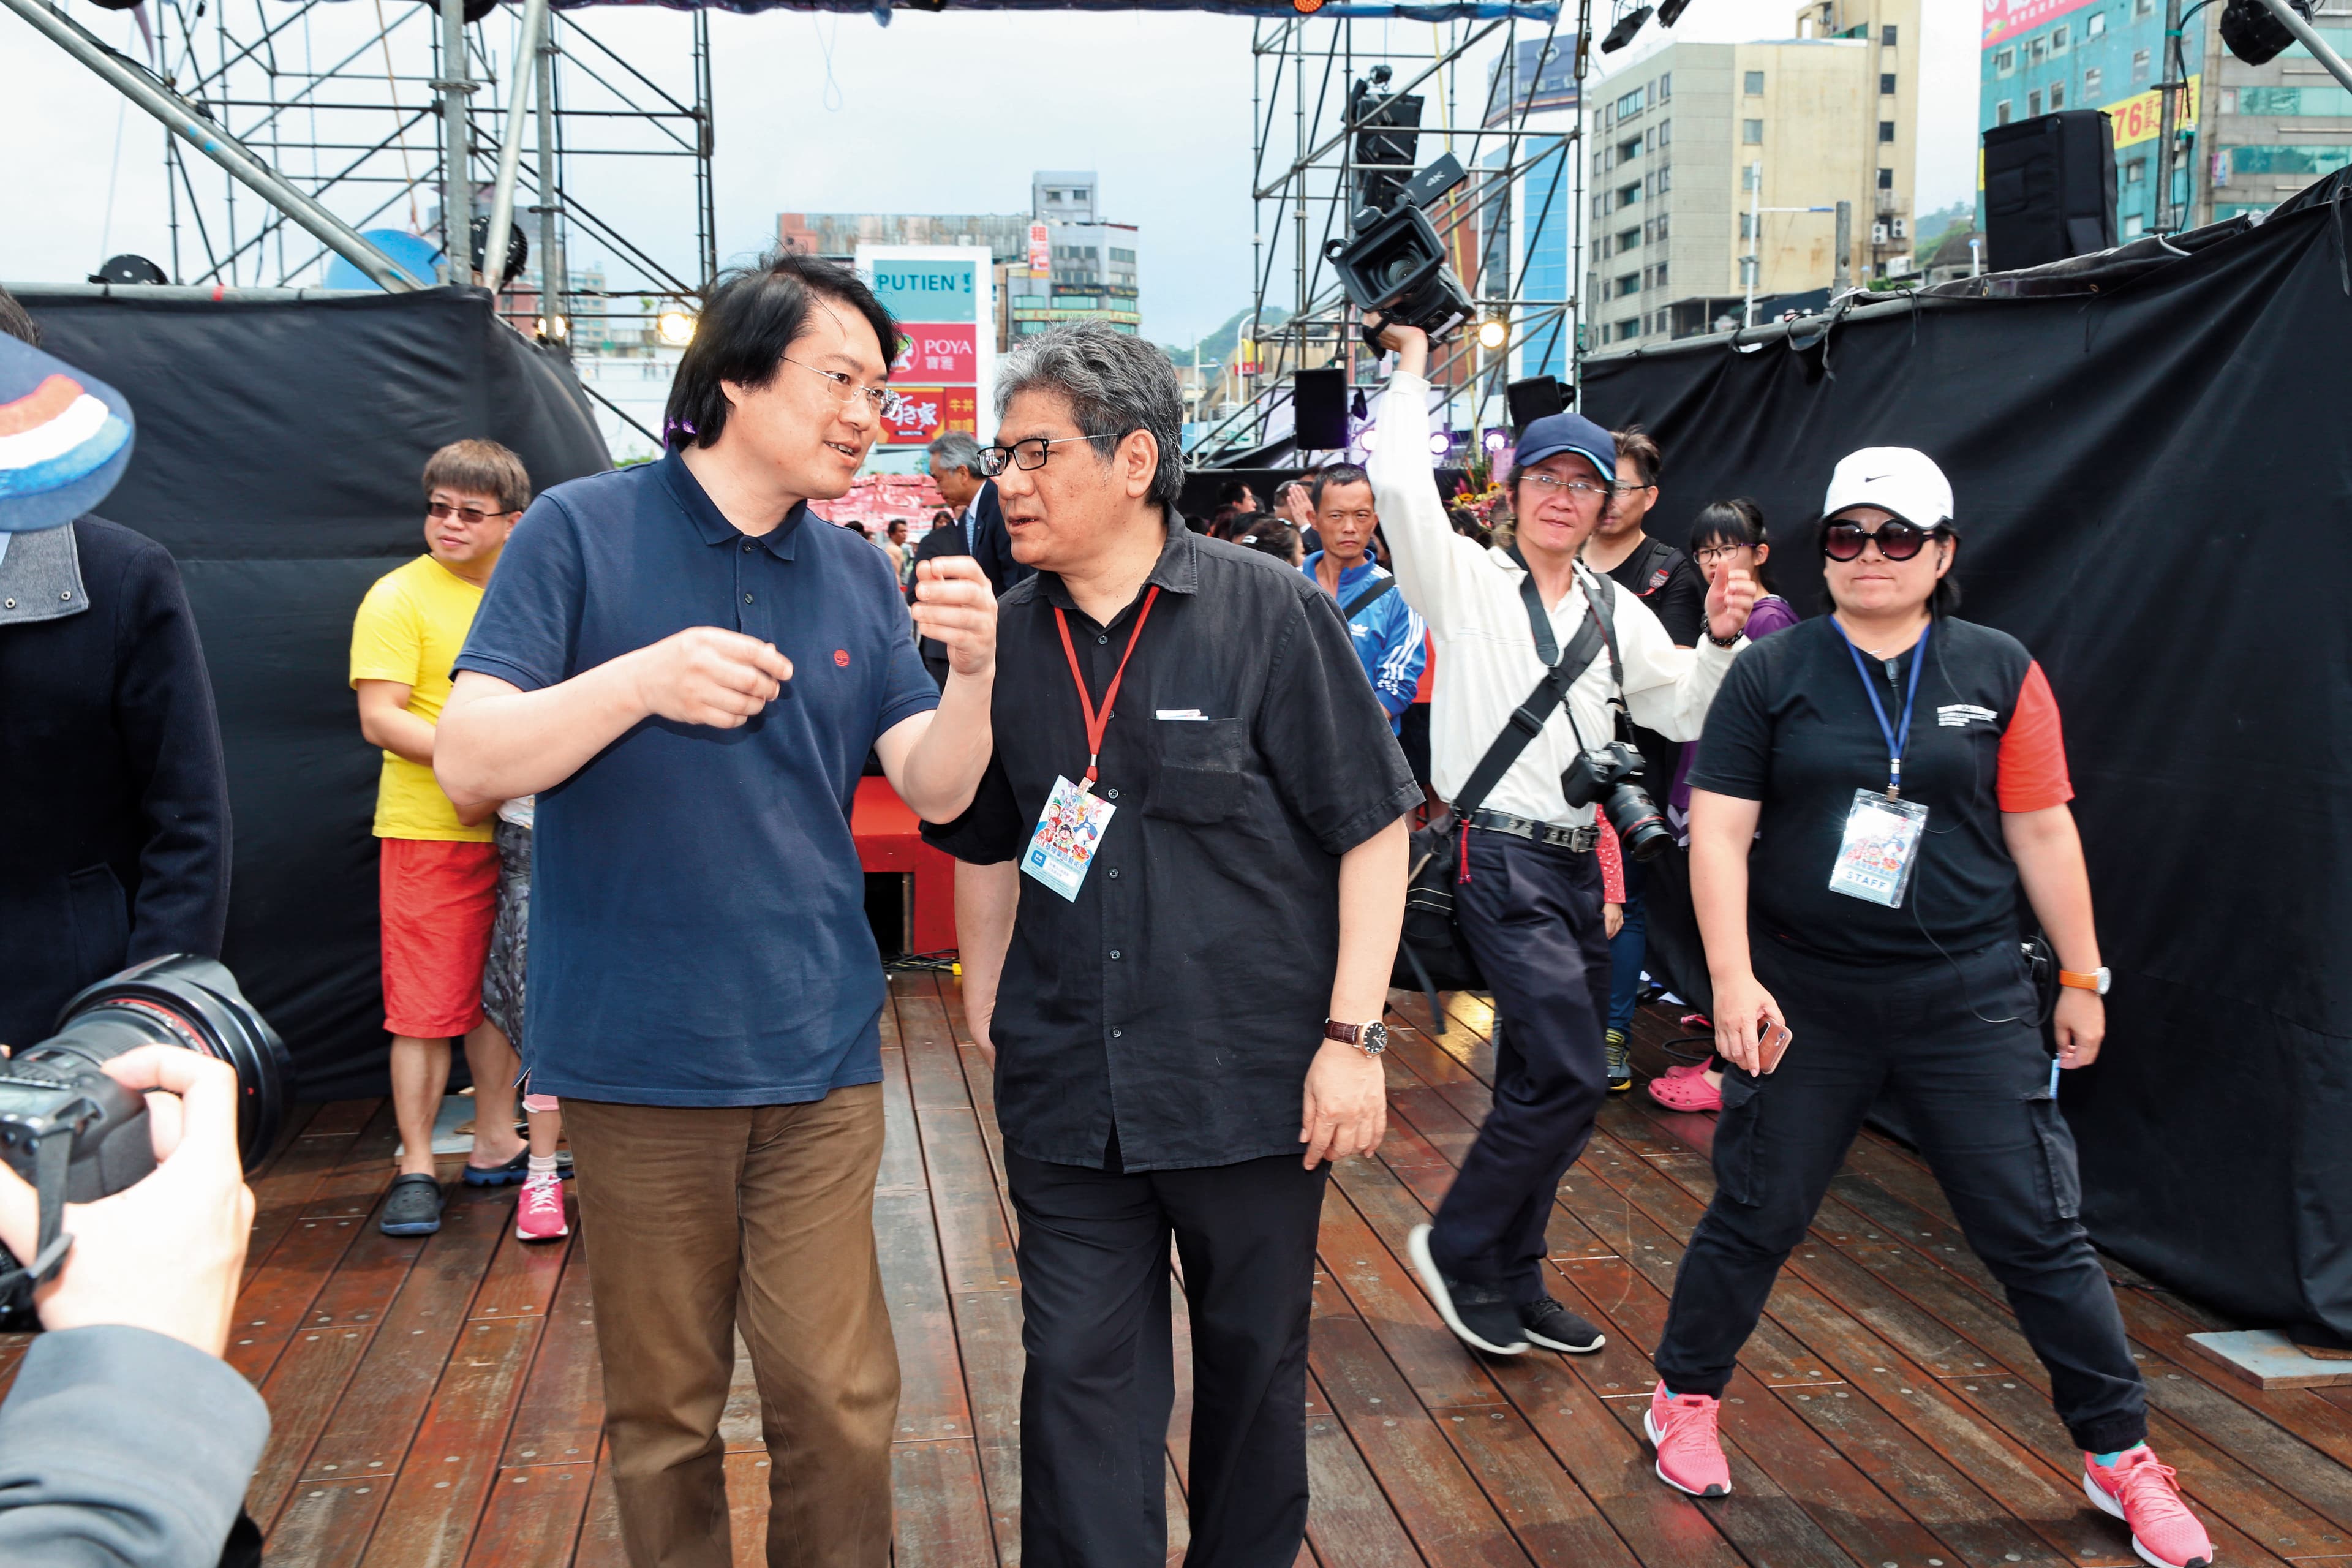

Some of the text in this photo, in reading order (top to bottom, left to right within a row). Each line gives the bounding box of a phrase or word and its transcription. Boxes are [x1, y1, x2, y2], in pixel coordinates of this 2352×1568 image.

[878, 274, 955, 291] PUTIEN
[924, 339, 973, 354] POYA
[1847, 871, 1887, 889] STAFF
